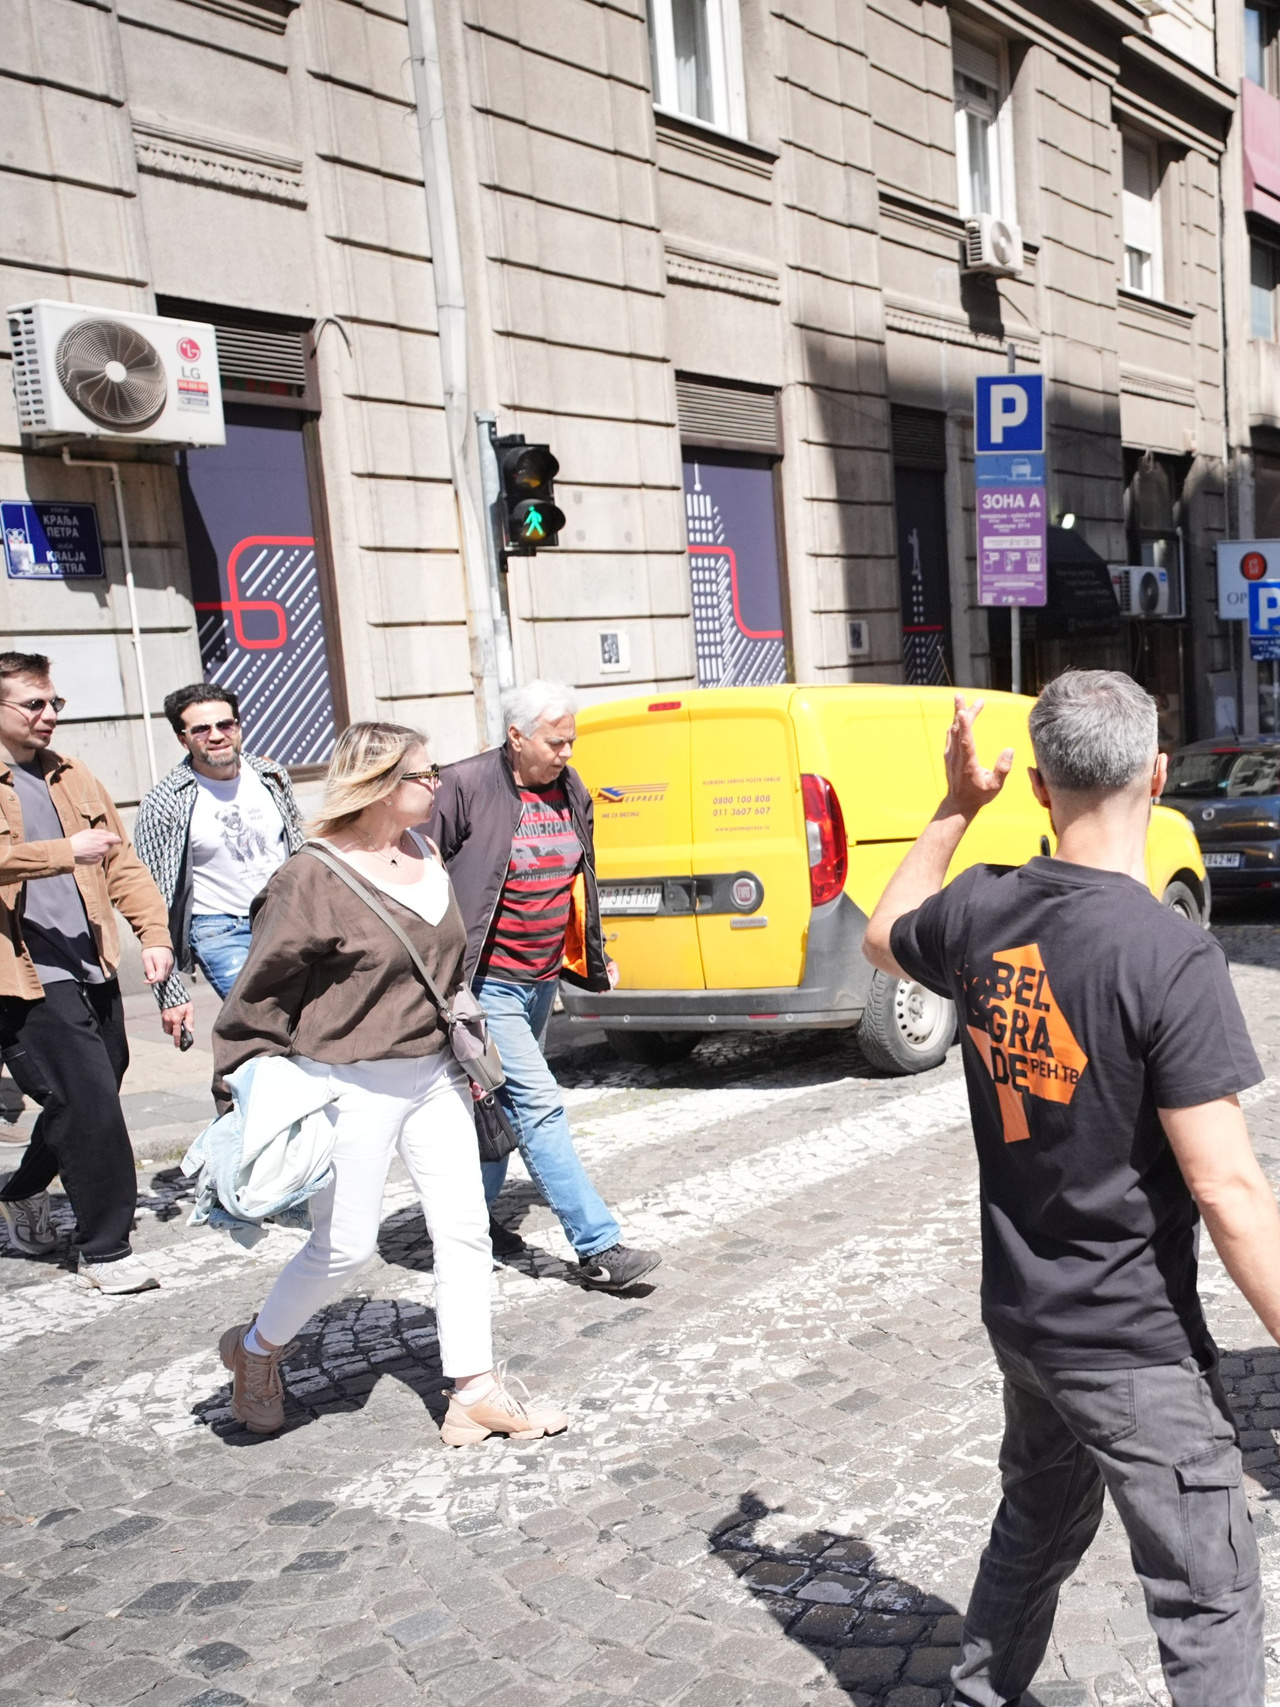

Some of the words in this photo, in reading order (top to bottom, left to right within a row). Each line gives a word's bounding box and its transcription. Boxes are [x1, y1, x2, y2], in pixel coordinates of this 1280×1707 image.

[181, 365, 201, 379] LG
[990, 383, 1028, 444] P
[983, 494, 1025, 509] ЗОНА
[1029, 493, 1041, 508] А
[42, 514, 79, 526] КРАЉА
[46, 526, 79, 537] ПЕТРА
[46, 550, 86, 562] KRALJA
[51, 562, 85, 573] PETRA
[1227, 592, 1247, 605] OP
[625, 794, 665, 803] EXPRESS
[713, 796, 733, 805] 0800
[737, 795, 752, 804] 100
[755, 794, 771, 803] 808
[713, 808, 728, 817] 011
[731, 807, 752, 816] 3607
[755, 806, 771, 815] 607
[737, 887, 751, 899] FIAT
[989, 961, 1050, 1012] BEL
[986, 1004, 1054, 1058] GRA
[990, 1046, 1030, 1093] DE
